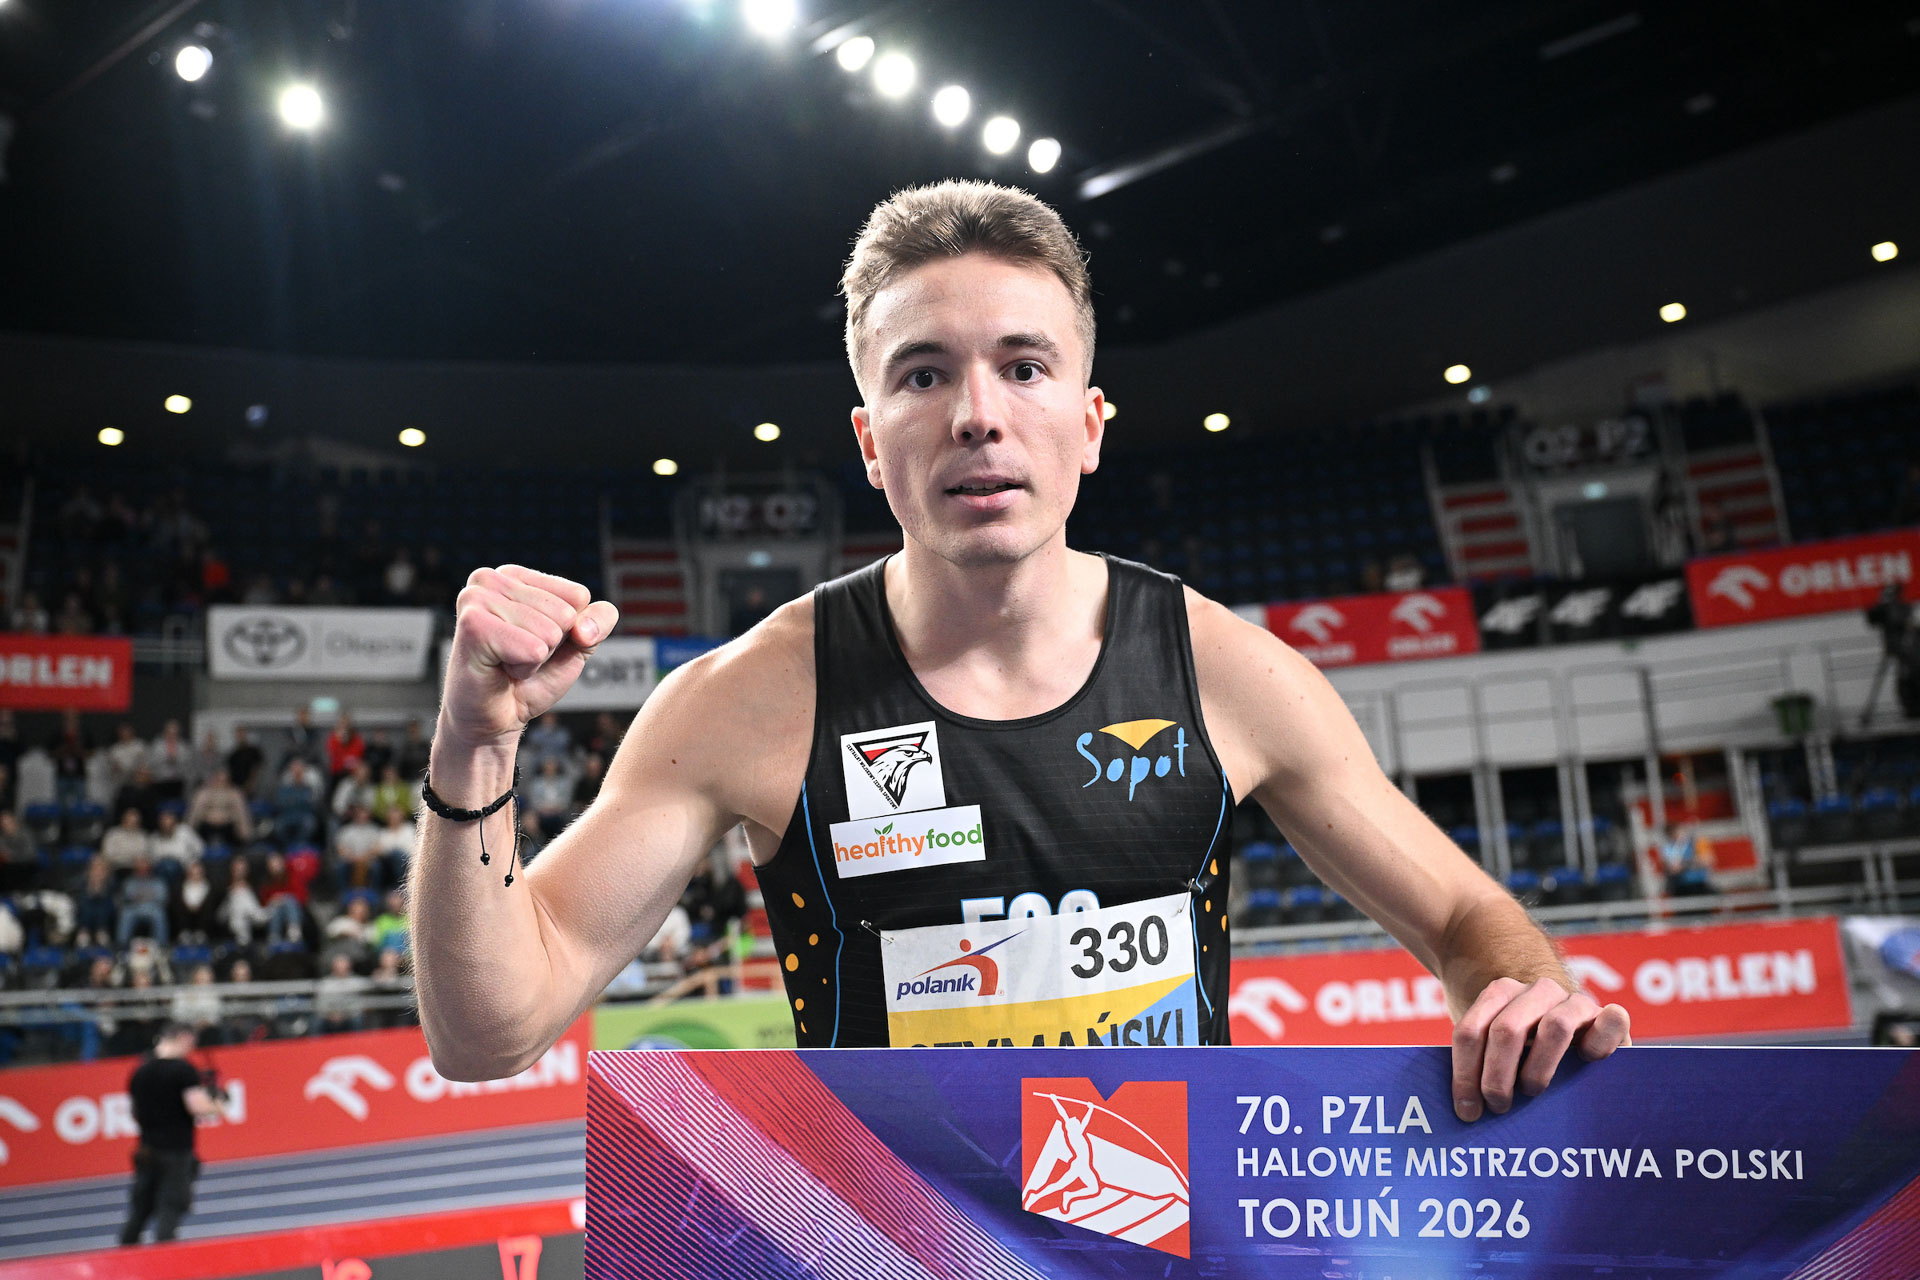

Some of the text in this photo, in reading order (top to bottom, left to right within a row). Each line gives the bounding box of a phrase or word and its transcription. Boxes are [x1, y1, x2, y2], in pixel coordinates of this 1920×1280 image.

[1780, 552, 1911, 596] ORLEN
[0, 653, 112, 688] RLEN
[1076, 727, 1189, 801] Sopot
[834, 824, 982, 862] healthyfood
[1070, 915, 1168, 979] 330
[896, 973, 976, 1001] polanik
[1633, 950, 1816, 1005] ORLEN
[1314, 976, 1449, 1026] ORLE
[1236, 1096, 1432, 1135] 70. PZLA
[1237, 1147, 1804, 1181] HALOWE MISTRZOSTWA POLSKI
[1238, 1187, 1531, 1239] TORUŃ 2026
